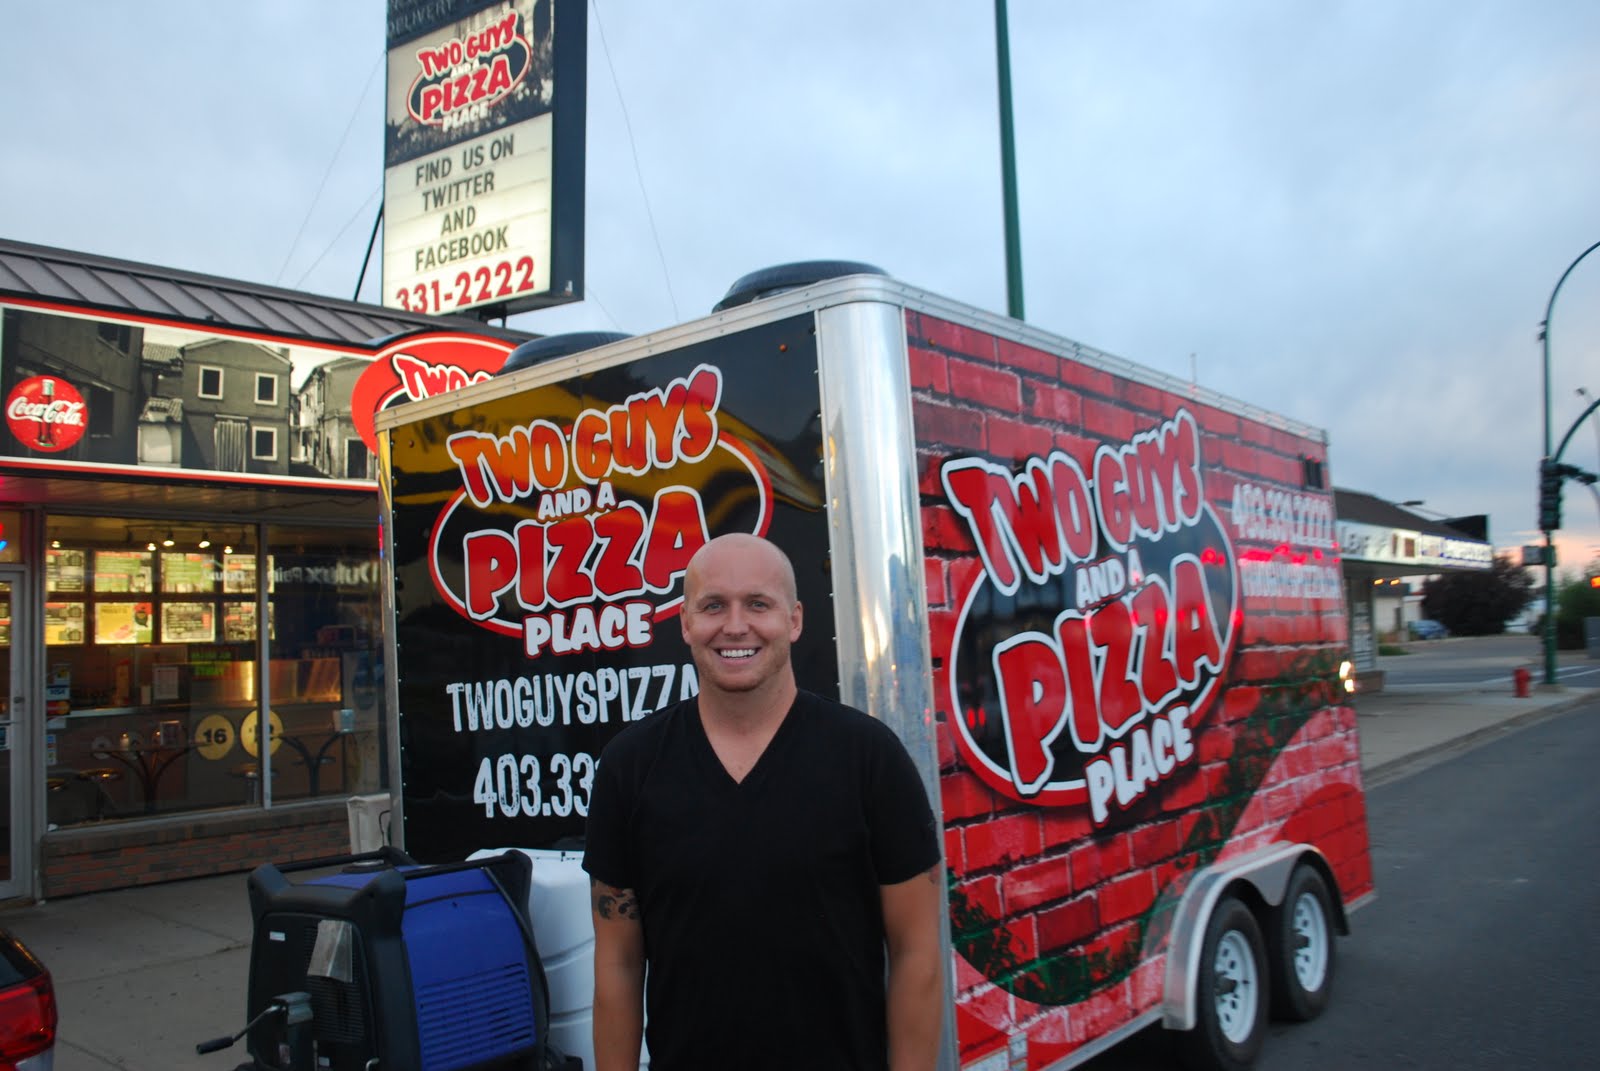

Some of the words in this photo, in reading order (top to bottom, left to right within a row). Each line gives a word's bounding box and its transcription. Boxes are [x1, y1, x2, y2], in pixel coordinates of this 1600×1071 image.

[416, 39, 464, 80] TWO
[465, 9, 519, 61] GUYS
[450, 63, 472, 77] AND
[472, 60, 481, 71] A
[420, 55, 512, 121] PIZZA
[442, 102, 490, 132] PLACE
[416, 158, 452, 186] FIND
[463, 145, 484, 170] US
[490, 133, 515, 160] ON
[422, 171, 495, 211] TWITTER
[415, 226, 509, 272] FACEBOOK
[441, 205, 476, 236] AND
[396, 256, 535, 314] 331-2222
[8, 396, 84, 426] Coca-Cola
[446, 419, 568, 507] TWO
[571, 363, 723, 484] GUYS
[537, 488, 592, 521] AND
[596, 481, 617, 509] A
[940, 450, 1098, 596] TWO
[1093, 408, 1202, 552] GUYS
[463, 485, 710, 620] PIZZA
[1075, 559, 1126, 608] AND
[1127, 547, 1145, 586] A
[522, 601, 654, 657] PLACE
[992, 553, 1224, 794] PIZZA
[203, 729, 228, 744] 16
[1085, 705, 1195, 824] PLACE
[473, 752, 601, 818] 403.33
